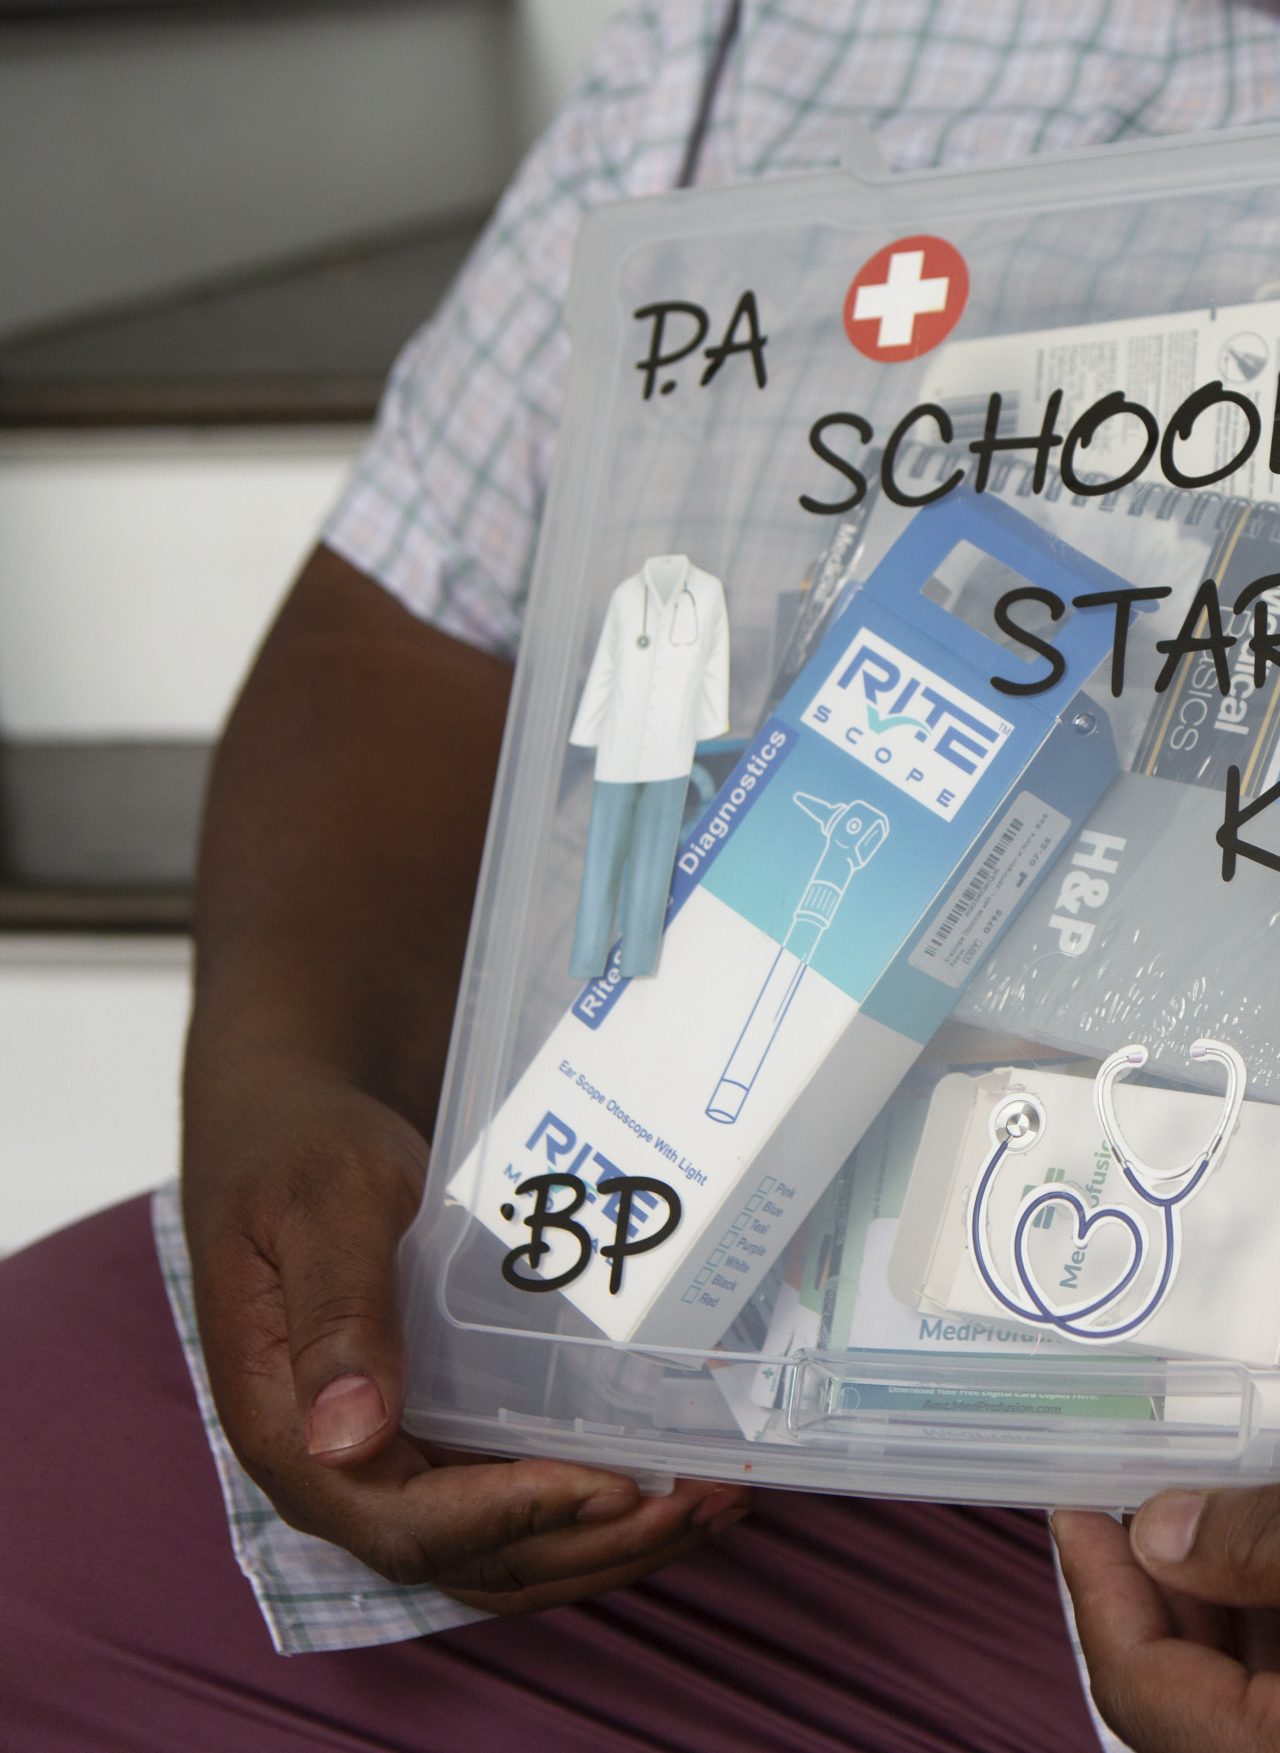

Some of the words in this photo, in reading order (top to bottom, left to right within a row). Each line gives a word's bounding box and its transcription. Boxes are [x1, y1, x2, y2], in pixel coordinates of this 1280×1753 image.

[1169, 605, 1253, 751] BSICS
[837, 645, 1000, 776] RITE
[813, 704, 956, 808] SCOPE
[678, 730, 787, 875] Diagnostics
[1048, 829, 1127, 958] H&P
[558, 1059, 577, 1079] Ear
[576, 1073, 606, 1104] Scope
[606, 1099, 653, 1143] Otoscope
[654, 1136, 679, 1166] With
[678, 1157, 709, 1187] Light
[775, 1181, 796, 1200] Pink
[762, 1200, 784, 1217] Blue
[750, 1218, 771, 1235] Teal
[736, 1236, 768, 1257] Purple
[724, 1254, 750, 1273] White
[711, 1273, 738, 1291] Black
[699, 1291, 720, 1308] Red
